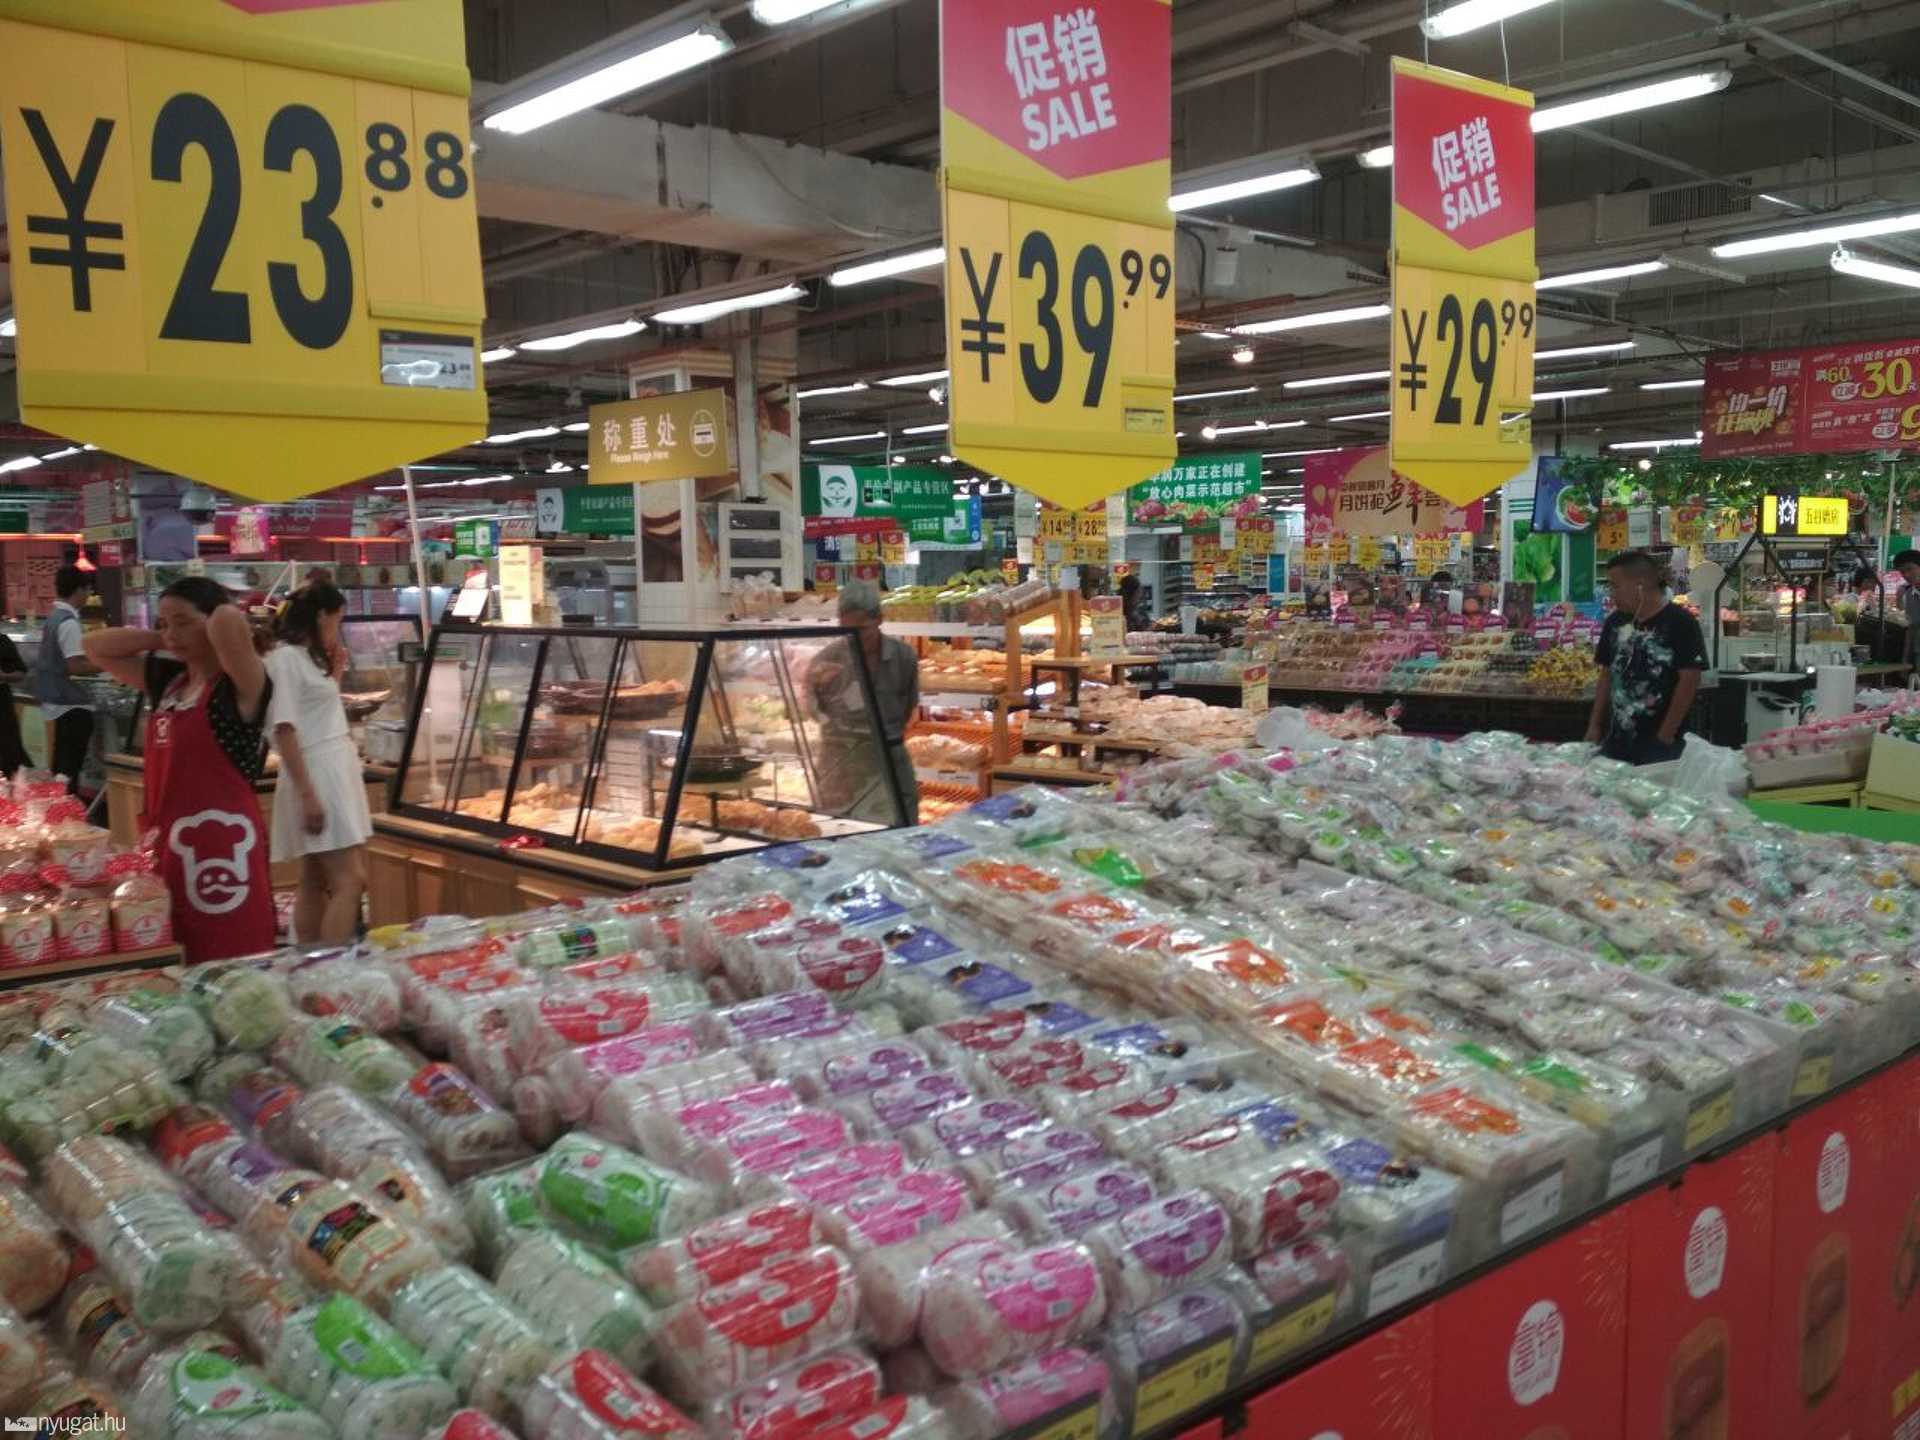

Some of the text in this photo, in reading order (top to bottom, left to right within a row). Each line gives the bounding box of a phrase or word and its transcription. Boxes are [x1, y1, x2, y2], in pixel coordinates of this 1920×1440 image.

[1006, 8, 1106, 99] 促销
[1022, 82, 1117, 151] SALE
[1432, 116, 1495, 191] 促销
[1442, 172, 1501, 230] SALE
[603, 412, 677, 452] 称重处
